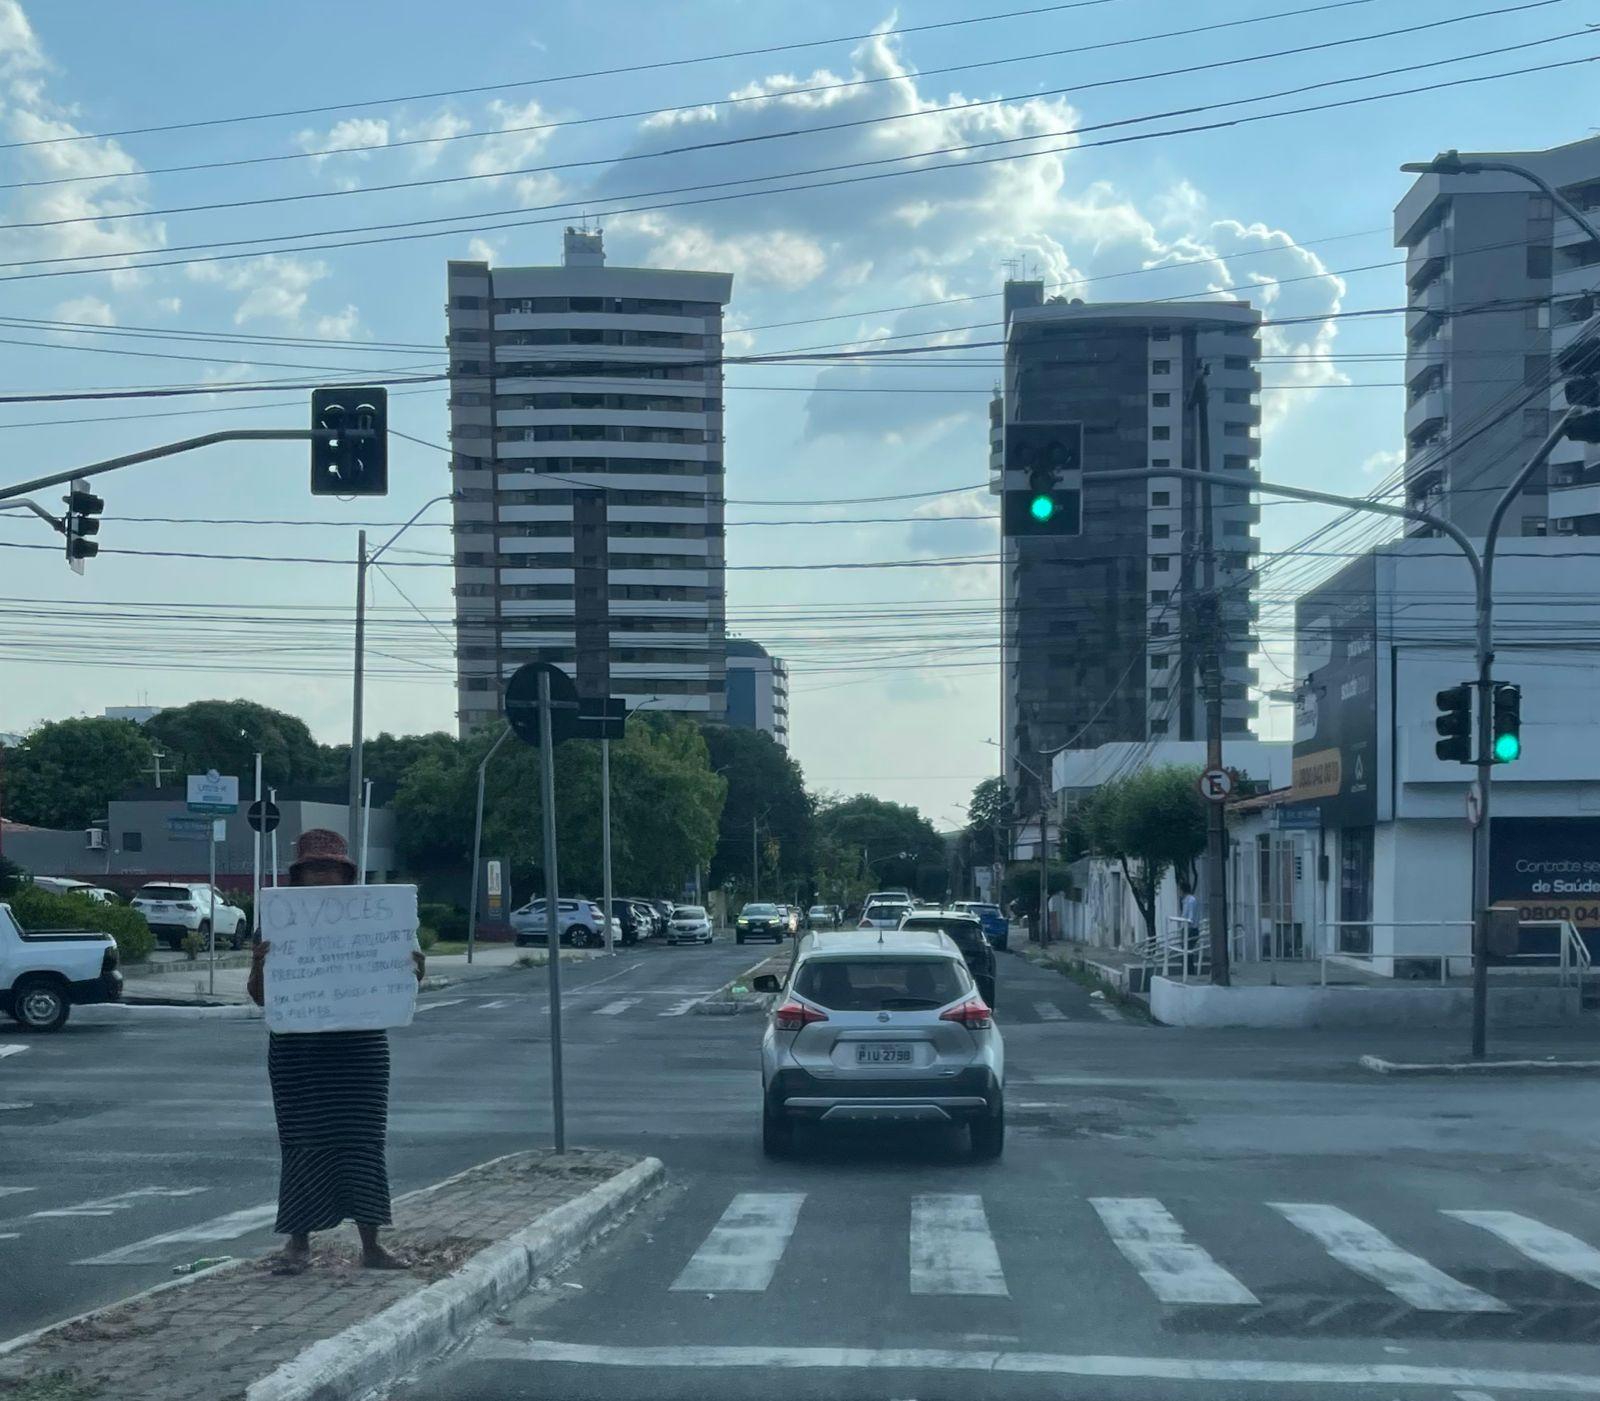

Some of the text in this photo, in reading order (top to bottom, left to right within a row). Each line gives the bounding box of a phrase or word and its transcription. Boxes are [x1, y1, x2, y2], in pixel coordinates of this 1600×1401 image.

[1209, 774, 1222, 795] E
[1515, 859, 1581, 873] Contrate
[1531, 878, 1600, 893] de Saúde
[1519, 905, 1569, 921] 0800
